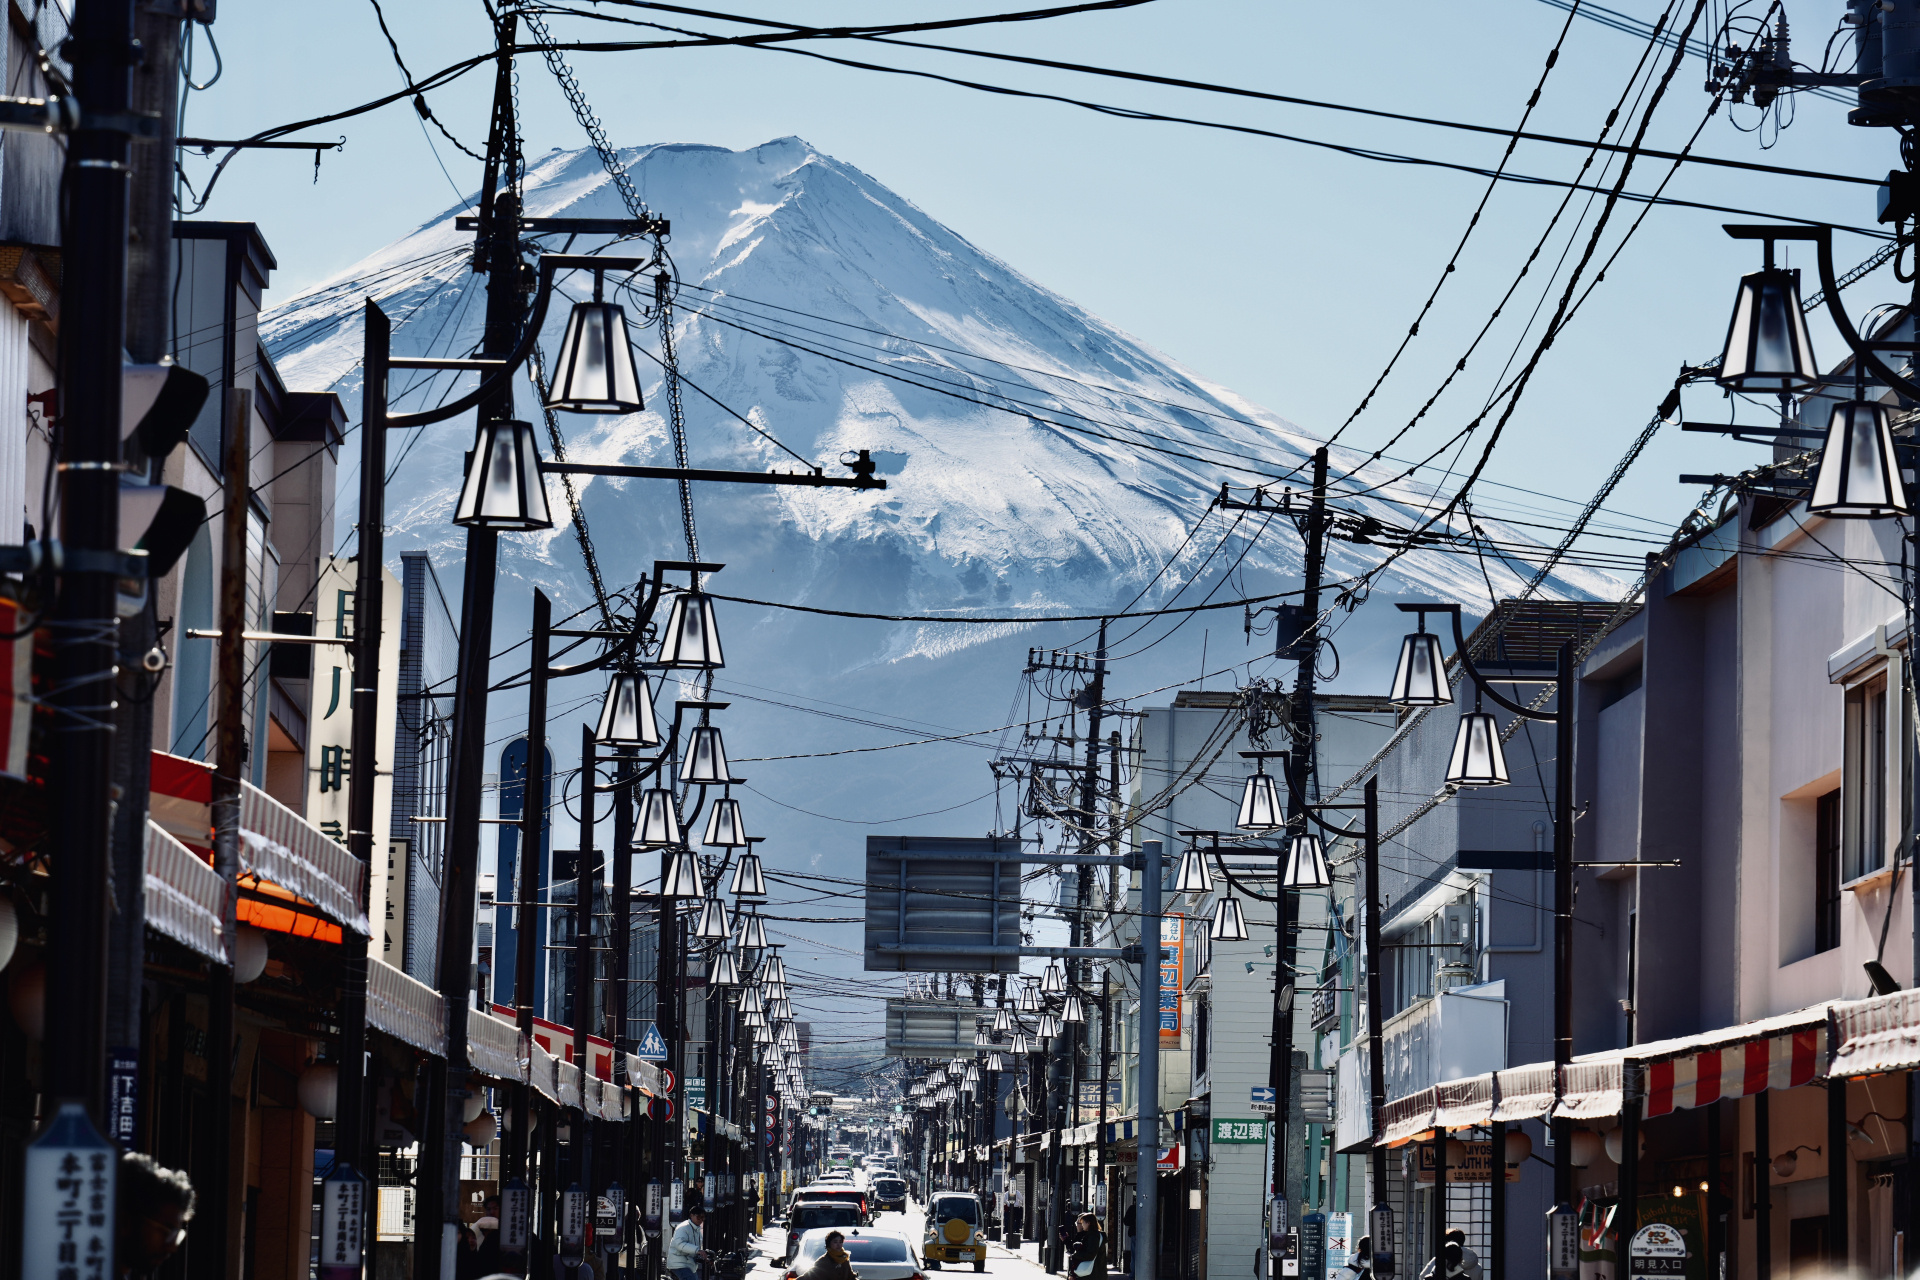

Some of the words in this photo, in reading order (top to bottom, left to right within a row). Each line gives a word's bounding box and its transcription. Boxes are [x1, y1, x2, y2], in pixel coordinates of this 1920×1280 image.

[1079, 1084, 1119, 1094] 立タクー
[1217, 1121, 1267, 1140] 渡辺薬
[1465, 1144, 1492, 1155] JIYOS
[335, 1182, 349, 1262] 本町二丁目商店街
[509, 1190, 519, 1245] 本町二丁目商店街
[1561, 1215, 1570, 1267] 本町二丁目商店街
[1634, 1259, 1682, 1270] 明見入口
